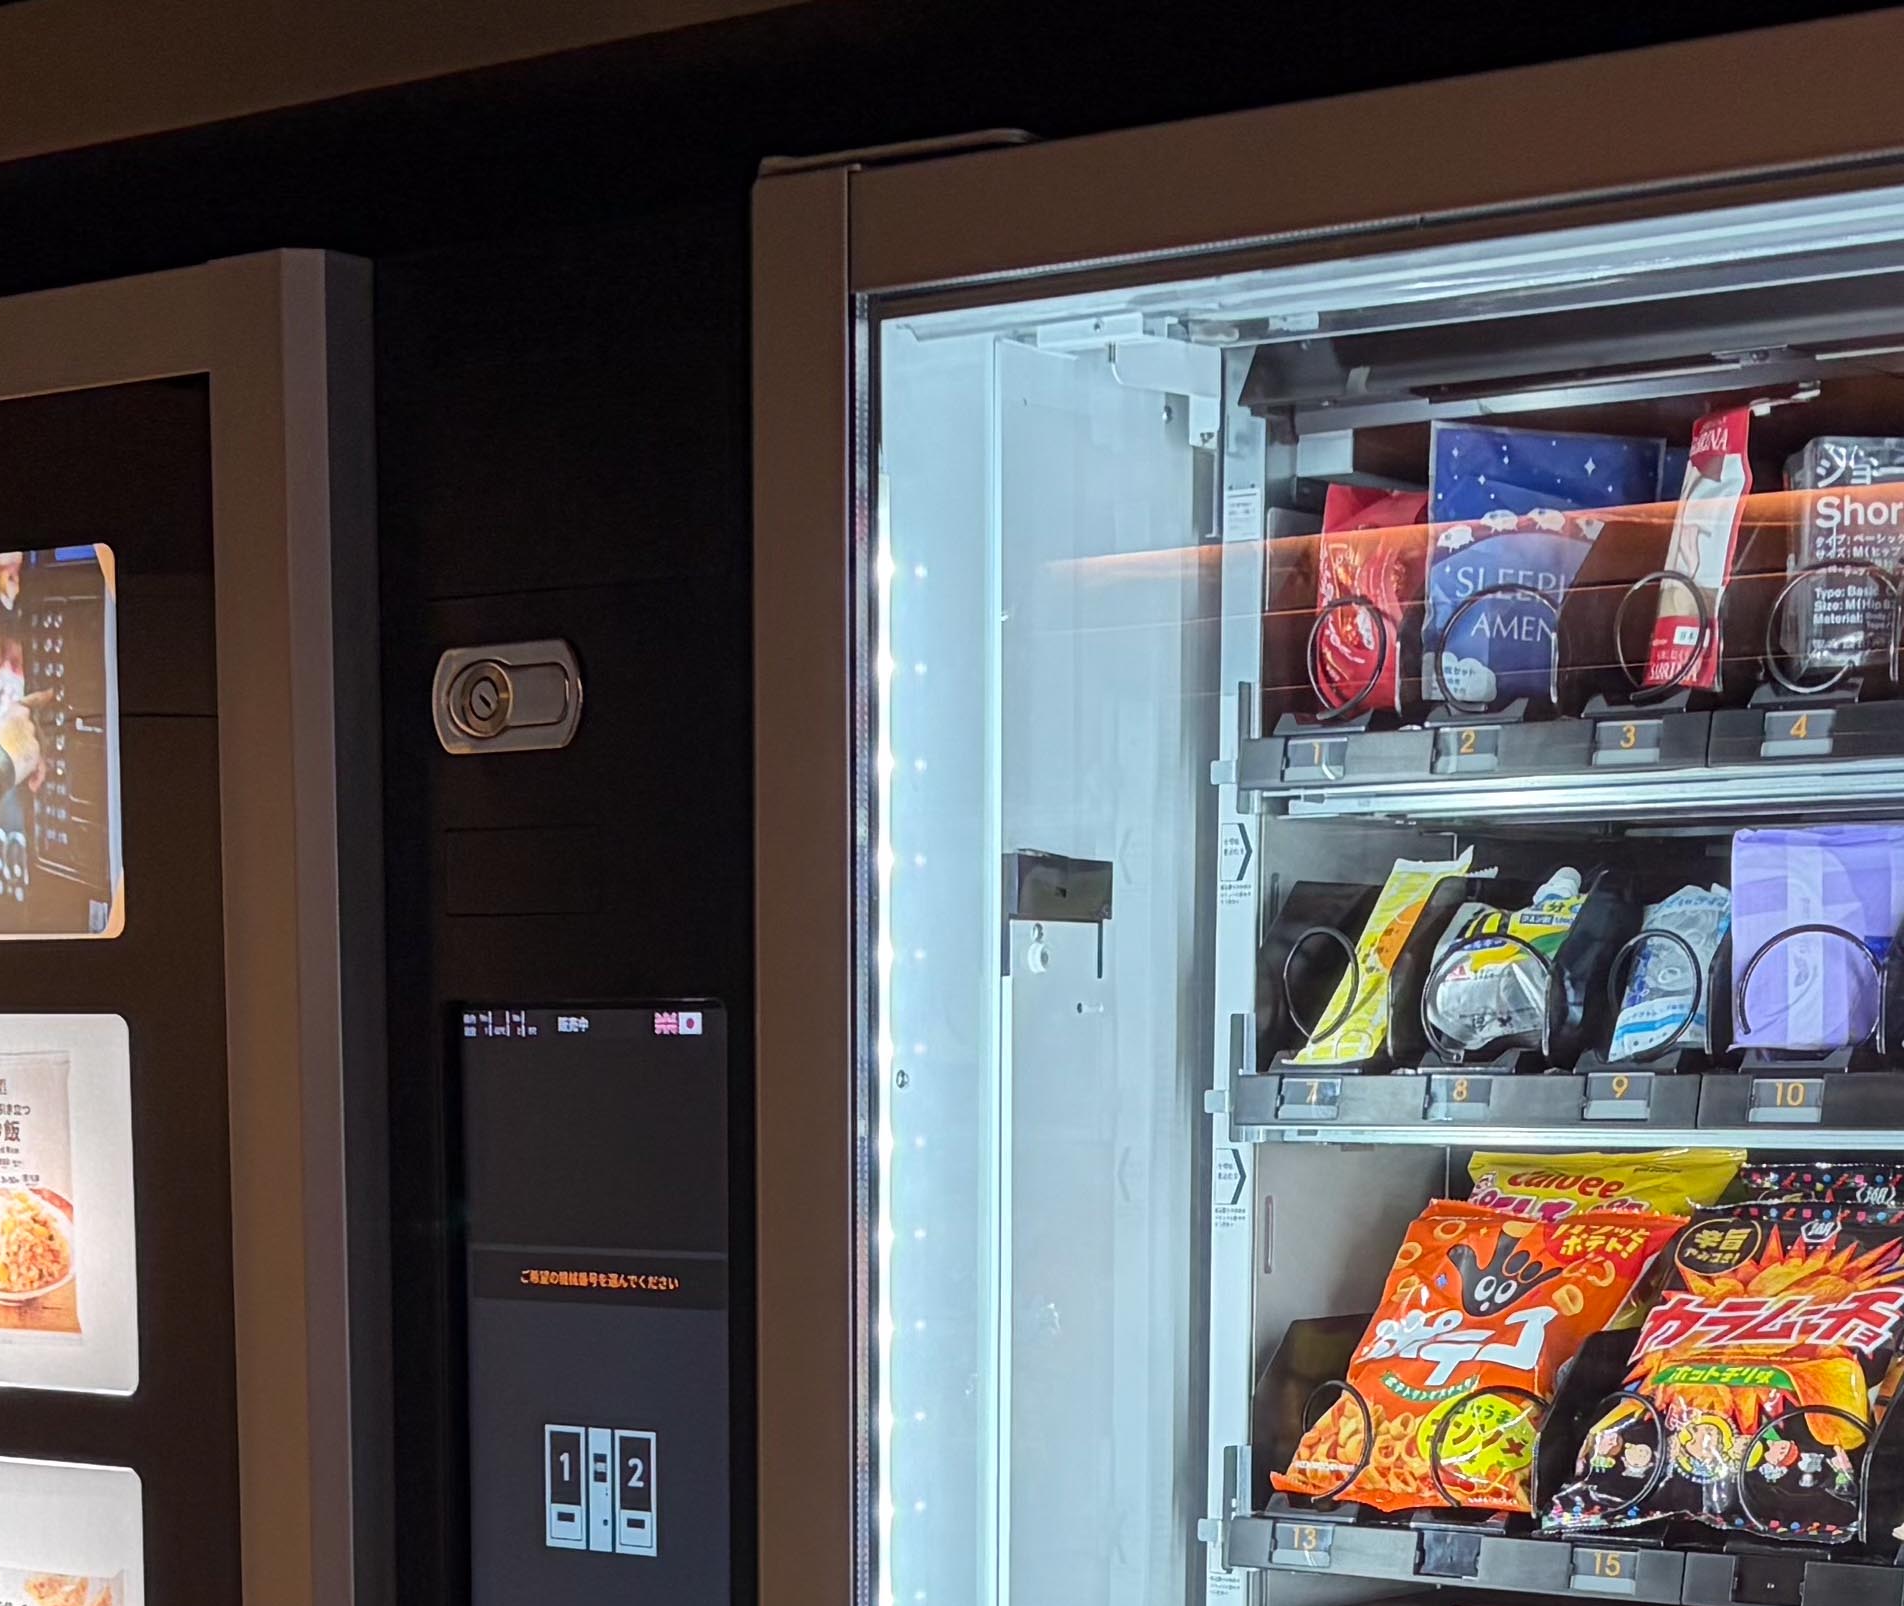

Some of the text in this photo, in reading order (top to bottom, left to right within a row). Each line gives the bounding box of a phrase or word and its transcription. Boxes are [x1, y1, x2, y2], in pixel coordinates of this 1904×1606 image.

[1619, 723, 1637, 749] 3
[1790, 714, 1808, 739] 4
[1459, 726, 1476, 754] 2
[1452, 1078, 1468, 1101] 8
[1611, 1075, 1629, 1099] 9
[1775, 1081, 1806, 1107] 10
[1559, 1233, 1639, 1259] ポテト!
[1671, 1365, 1775, 1384] ホットチリ味
[559, 1451, 571, 1481] 1
[626, 1457, 644, 1488] 2
[1291, 1526, 1317, 1550] 13
[1594, 1551, 1620, 1577] 15
